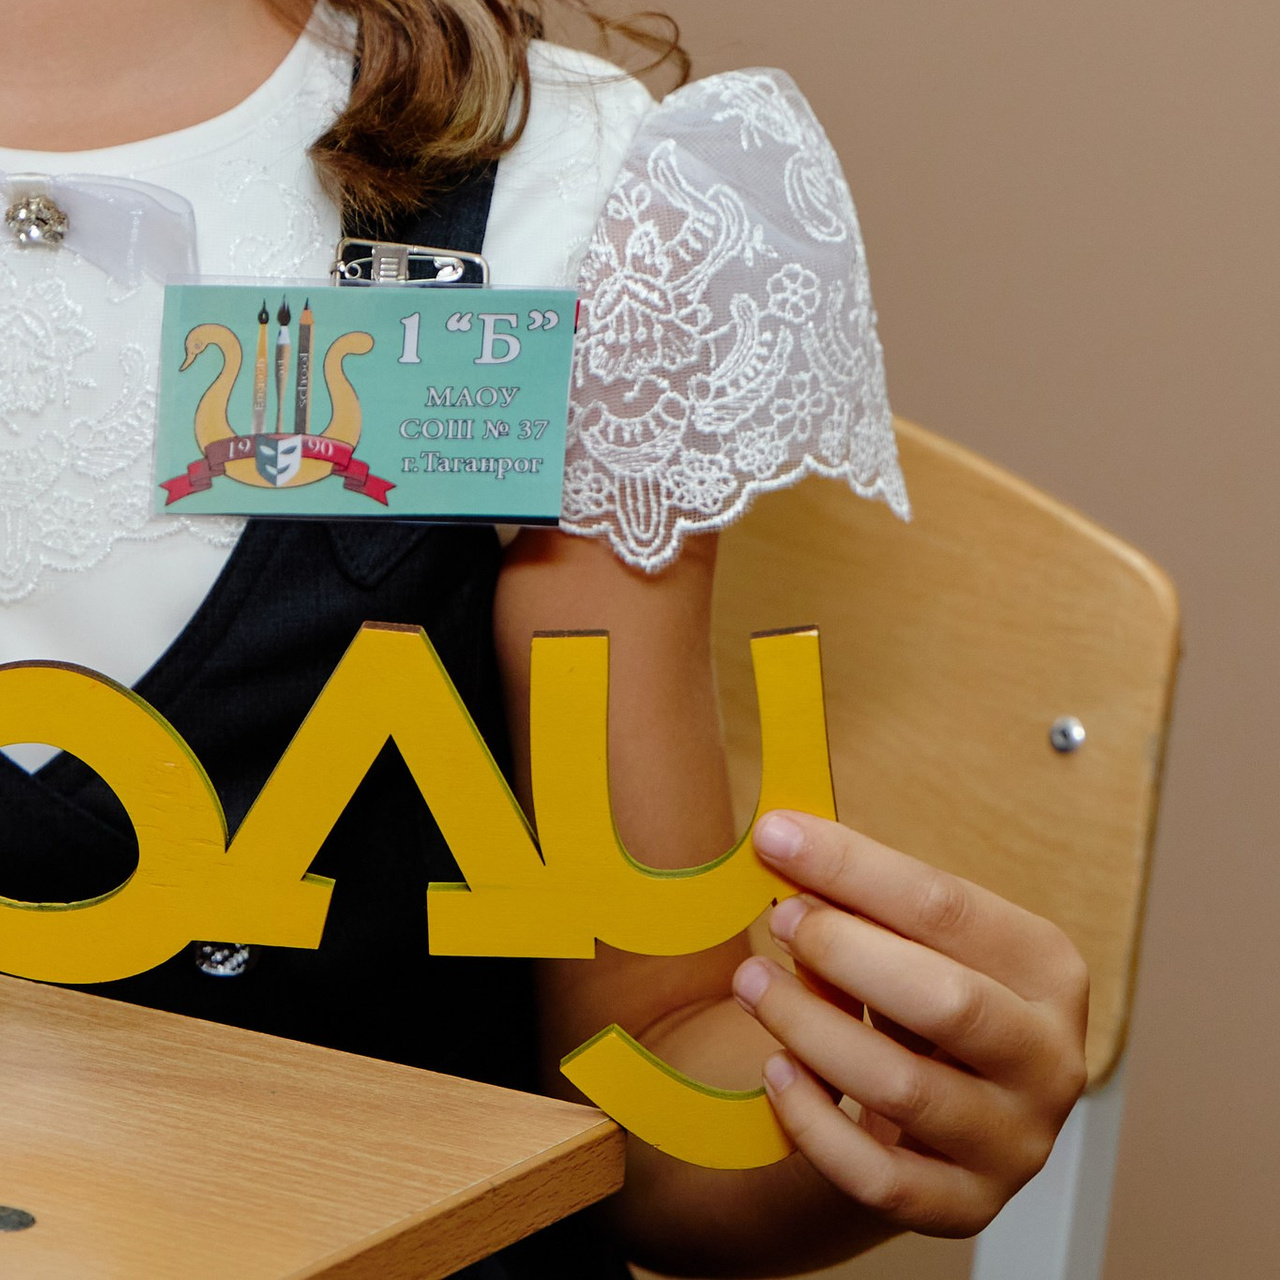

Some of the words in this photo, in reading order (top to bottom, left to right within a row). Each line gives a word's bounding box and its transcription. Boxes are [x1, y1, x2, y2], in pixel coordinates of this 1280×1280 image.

[397, 311, 422, 364] 1
[297, 351, 310, 408] school
[424, 386, 520, 408] МАОУ
[399, 418, 475, 440] СОШ
[483, 419, 510, 439] №
[517, 419, 550, 441] 37
